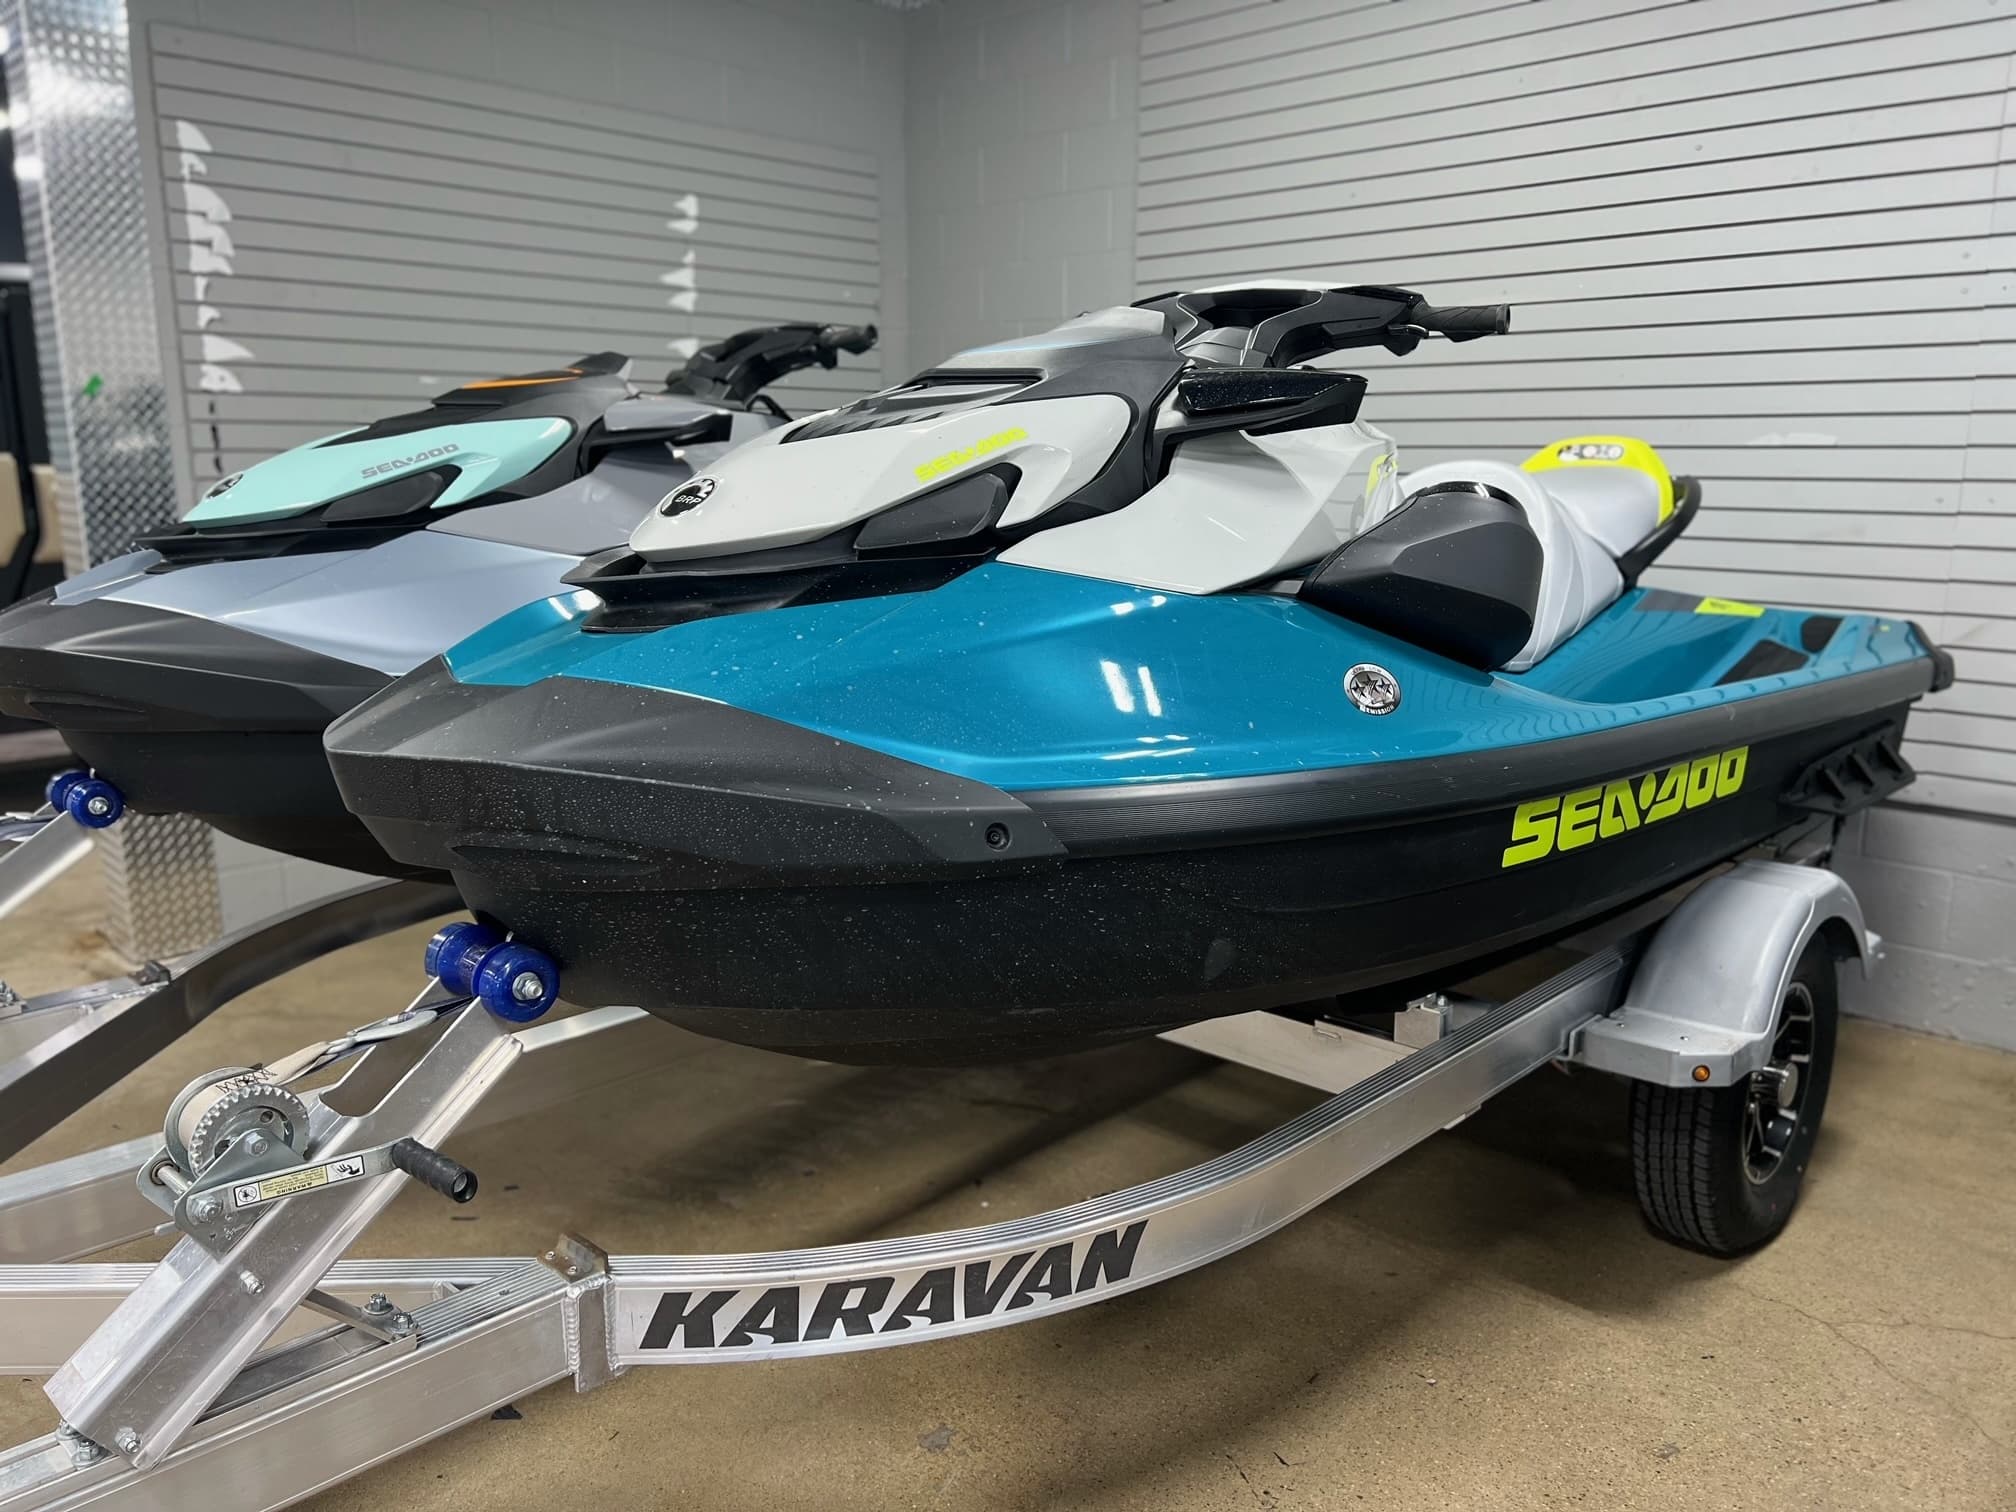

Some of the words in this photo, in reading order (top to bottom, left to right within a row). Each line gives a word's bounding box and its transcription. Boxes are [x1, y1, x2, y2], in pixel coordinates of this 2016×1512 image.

[675, 494, 702, 505] BRP
[276, 1182, 308, 1195] WARNING
[638, 1219, 1149, 1349] KARAVAN
